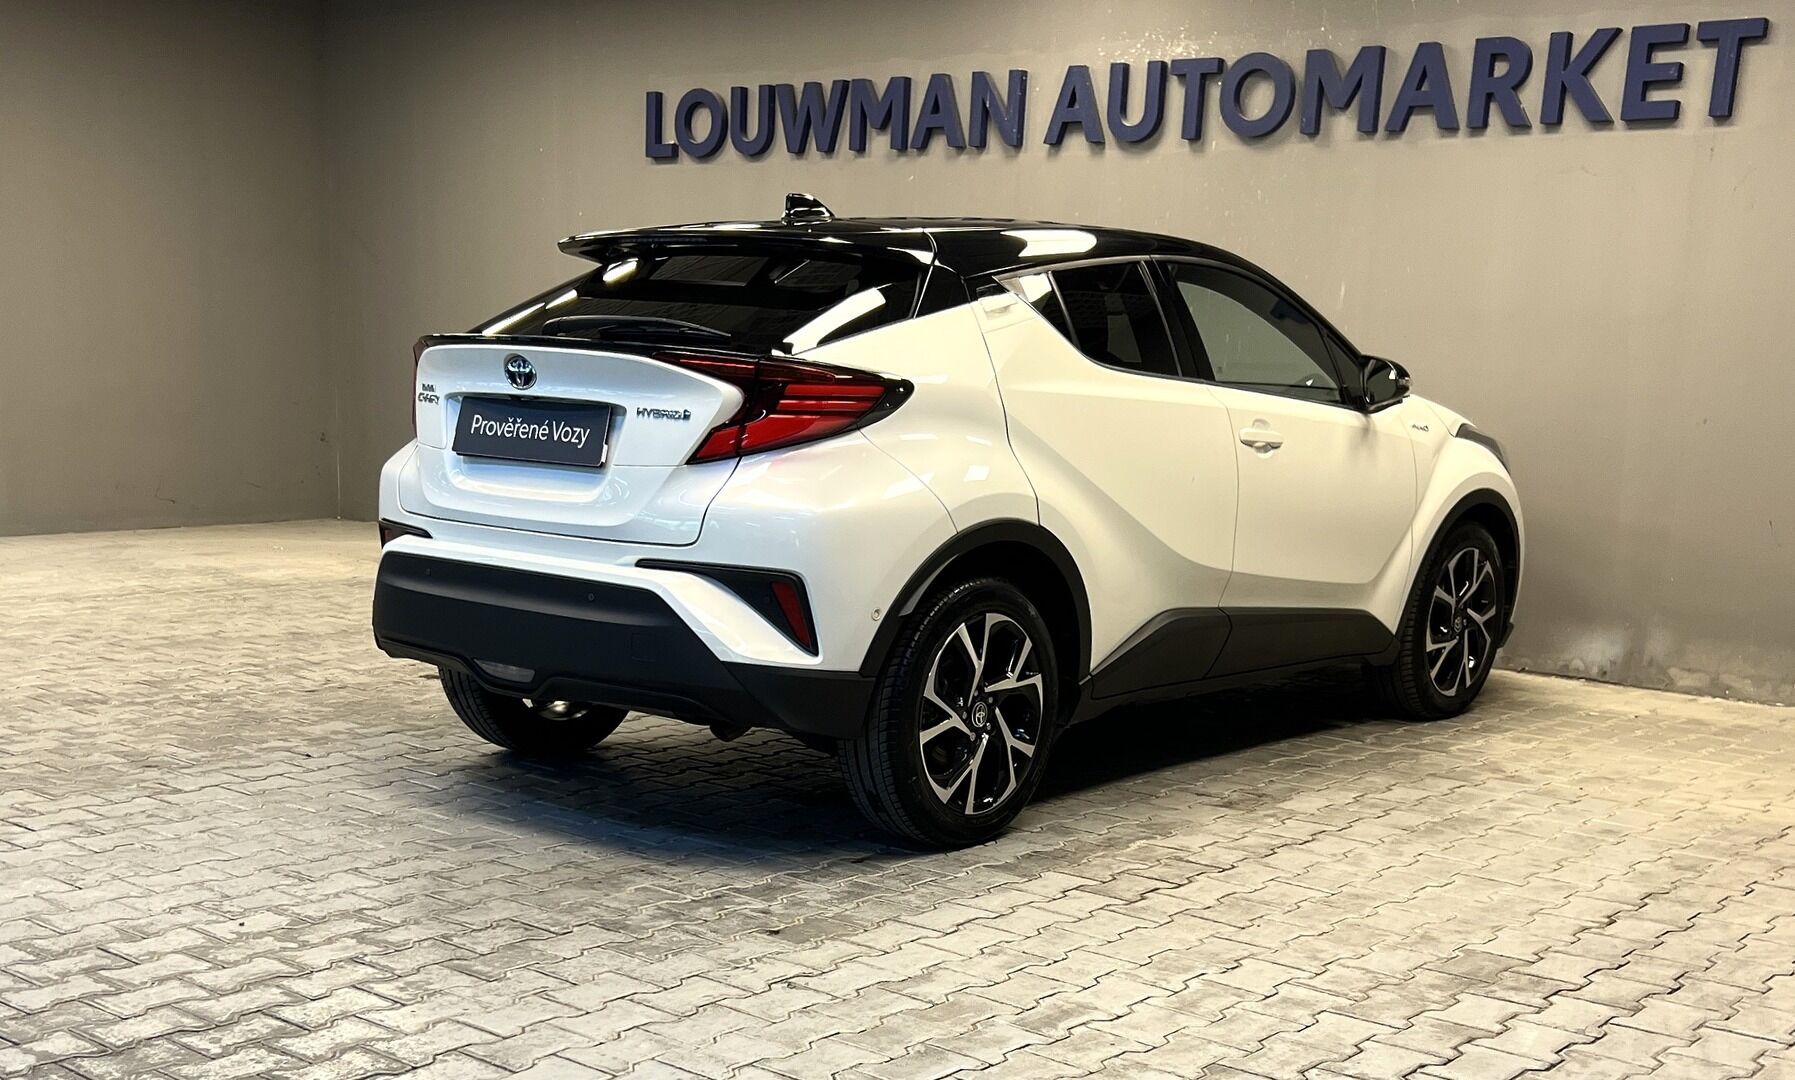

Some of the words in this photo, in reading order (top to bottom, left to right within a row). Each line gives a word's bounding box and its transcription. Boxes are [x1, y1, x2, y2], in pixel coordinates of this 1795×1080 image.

[645, 69, 1028, 159] LOUWMAN
[1043, 17, 1770, 147] AUTOMARKET
[470, 414, 549, 441] Prověřené
[552, 420, 590, 449] Vozy
